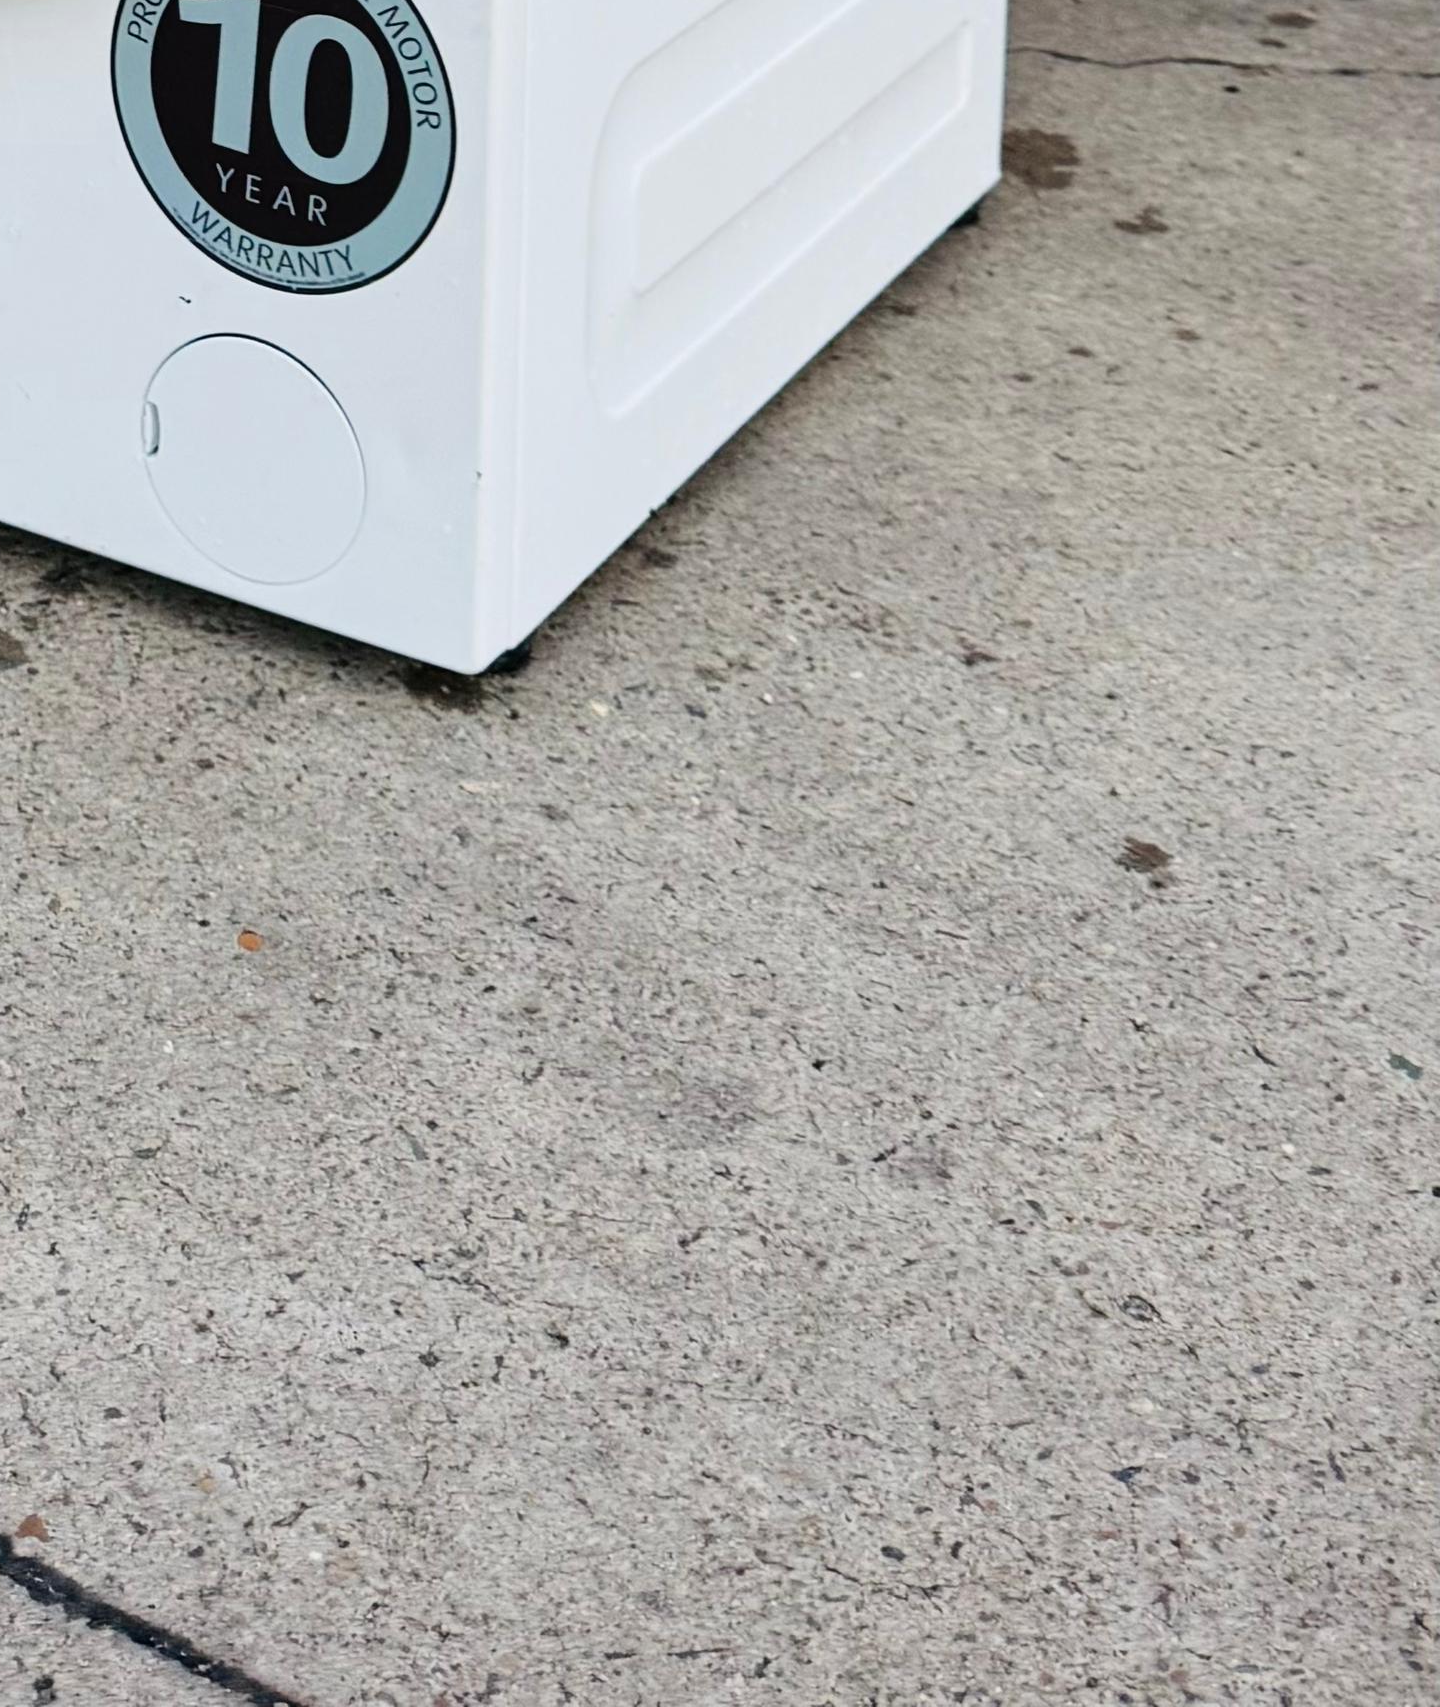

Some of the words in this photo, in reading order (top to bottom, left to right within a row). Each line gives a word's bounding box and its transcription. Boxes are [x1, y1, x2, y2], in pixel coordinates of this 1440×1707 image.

[378, 5, 443, 131] MOTOR
[216, 163, 329, 227] YEAR
[192, 200, 355, 278] WARRANTY
